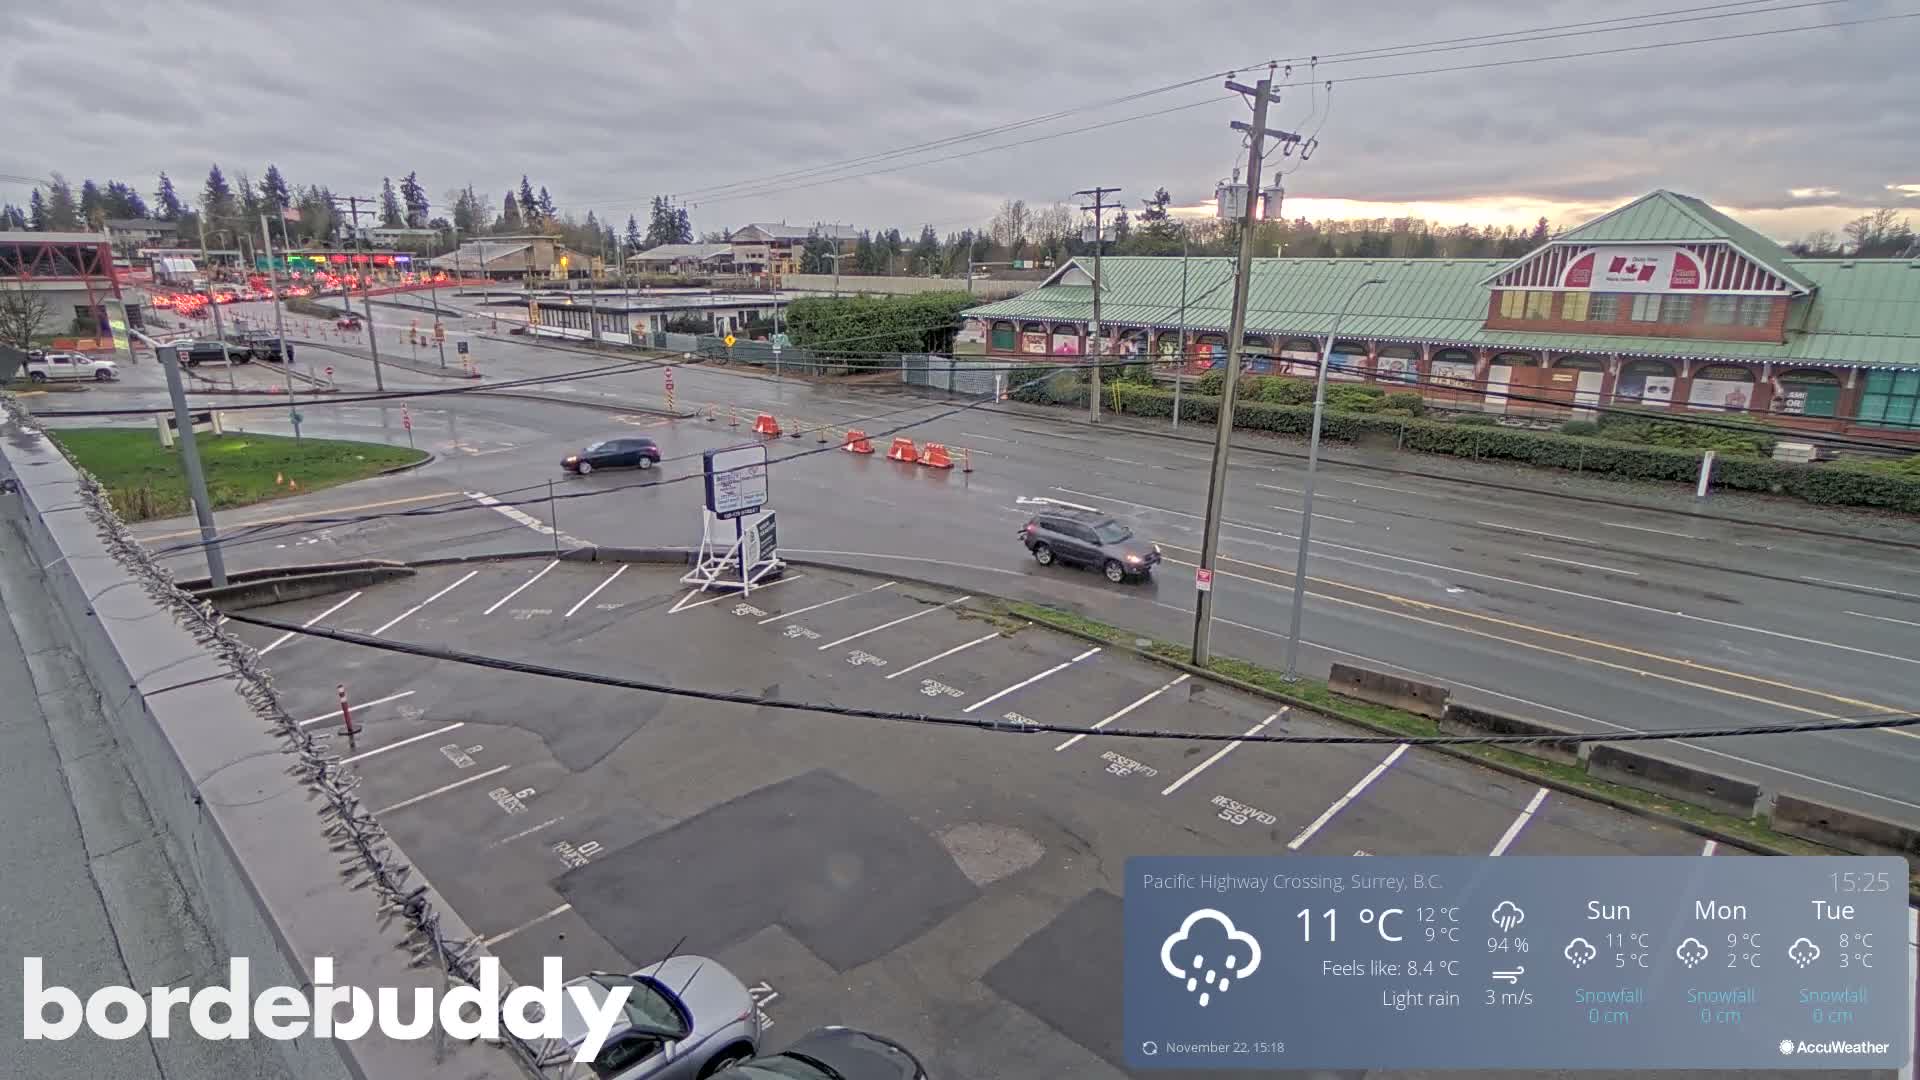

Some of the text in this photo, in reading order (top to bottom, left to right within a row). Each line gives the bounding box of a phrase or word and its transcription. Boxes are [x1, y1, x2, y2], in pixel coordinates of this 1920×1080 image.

[1100, 751, 1158, 777] RESERVED
[1210, 795, 1276, 825] RESERVED
[1217, 809, 1249, 825] 59
